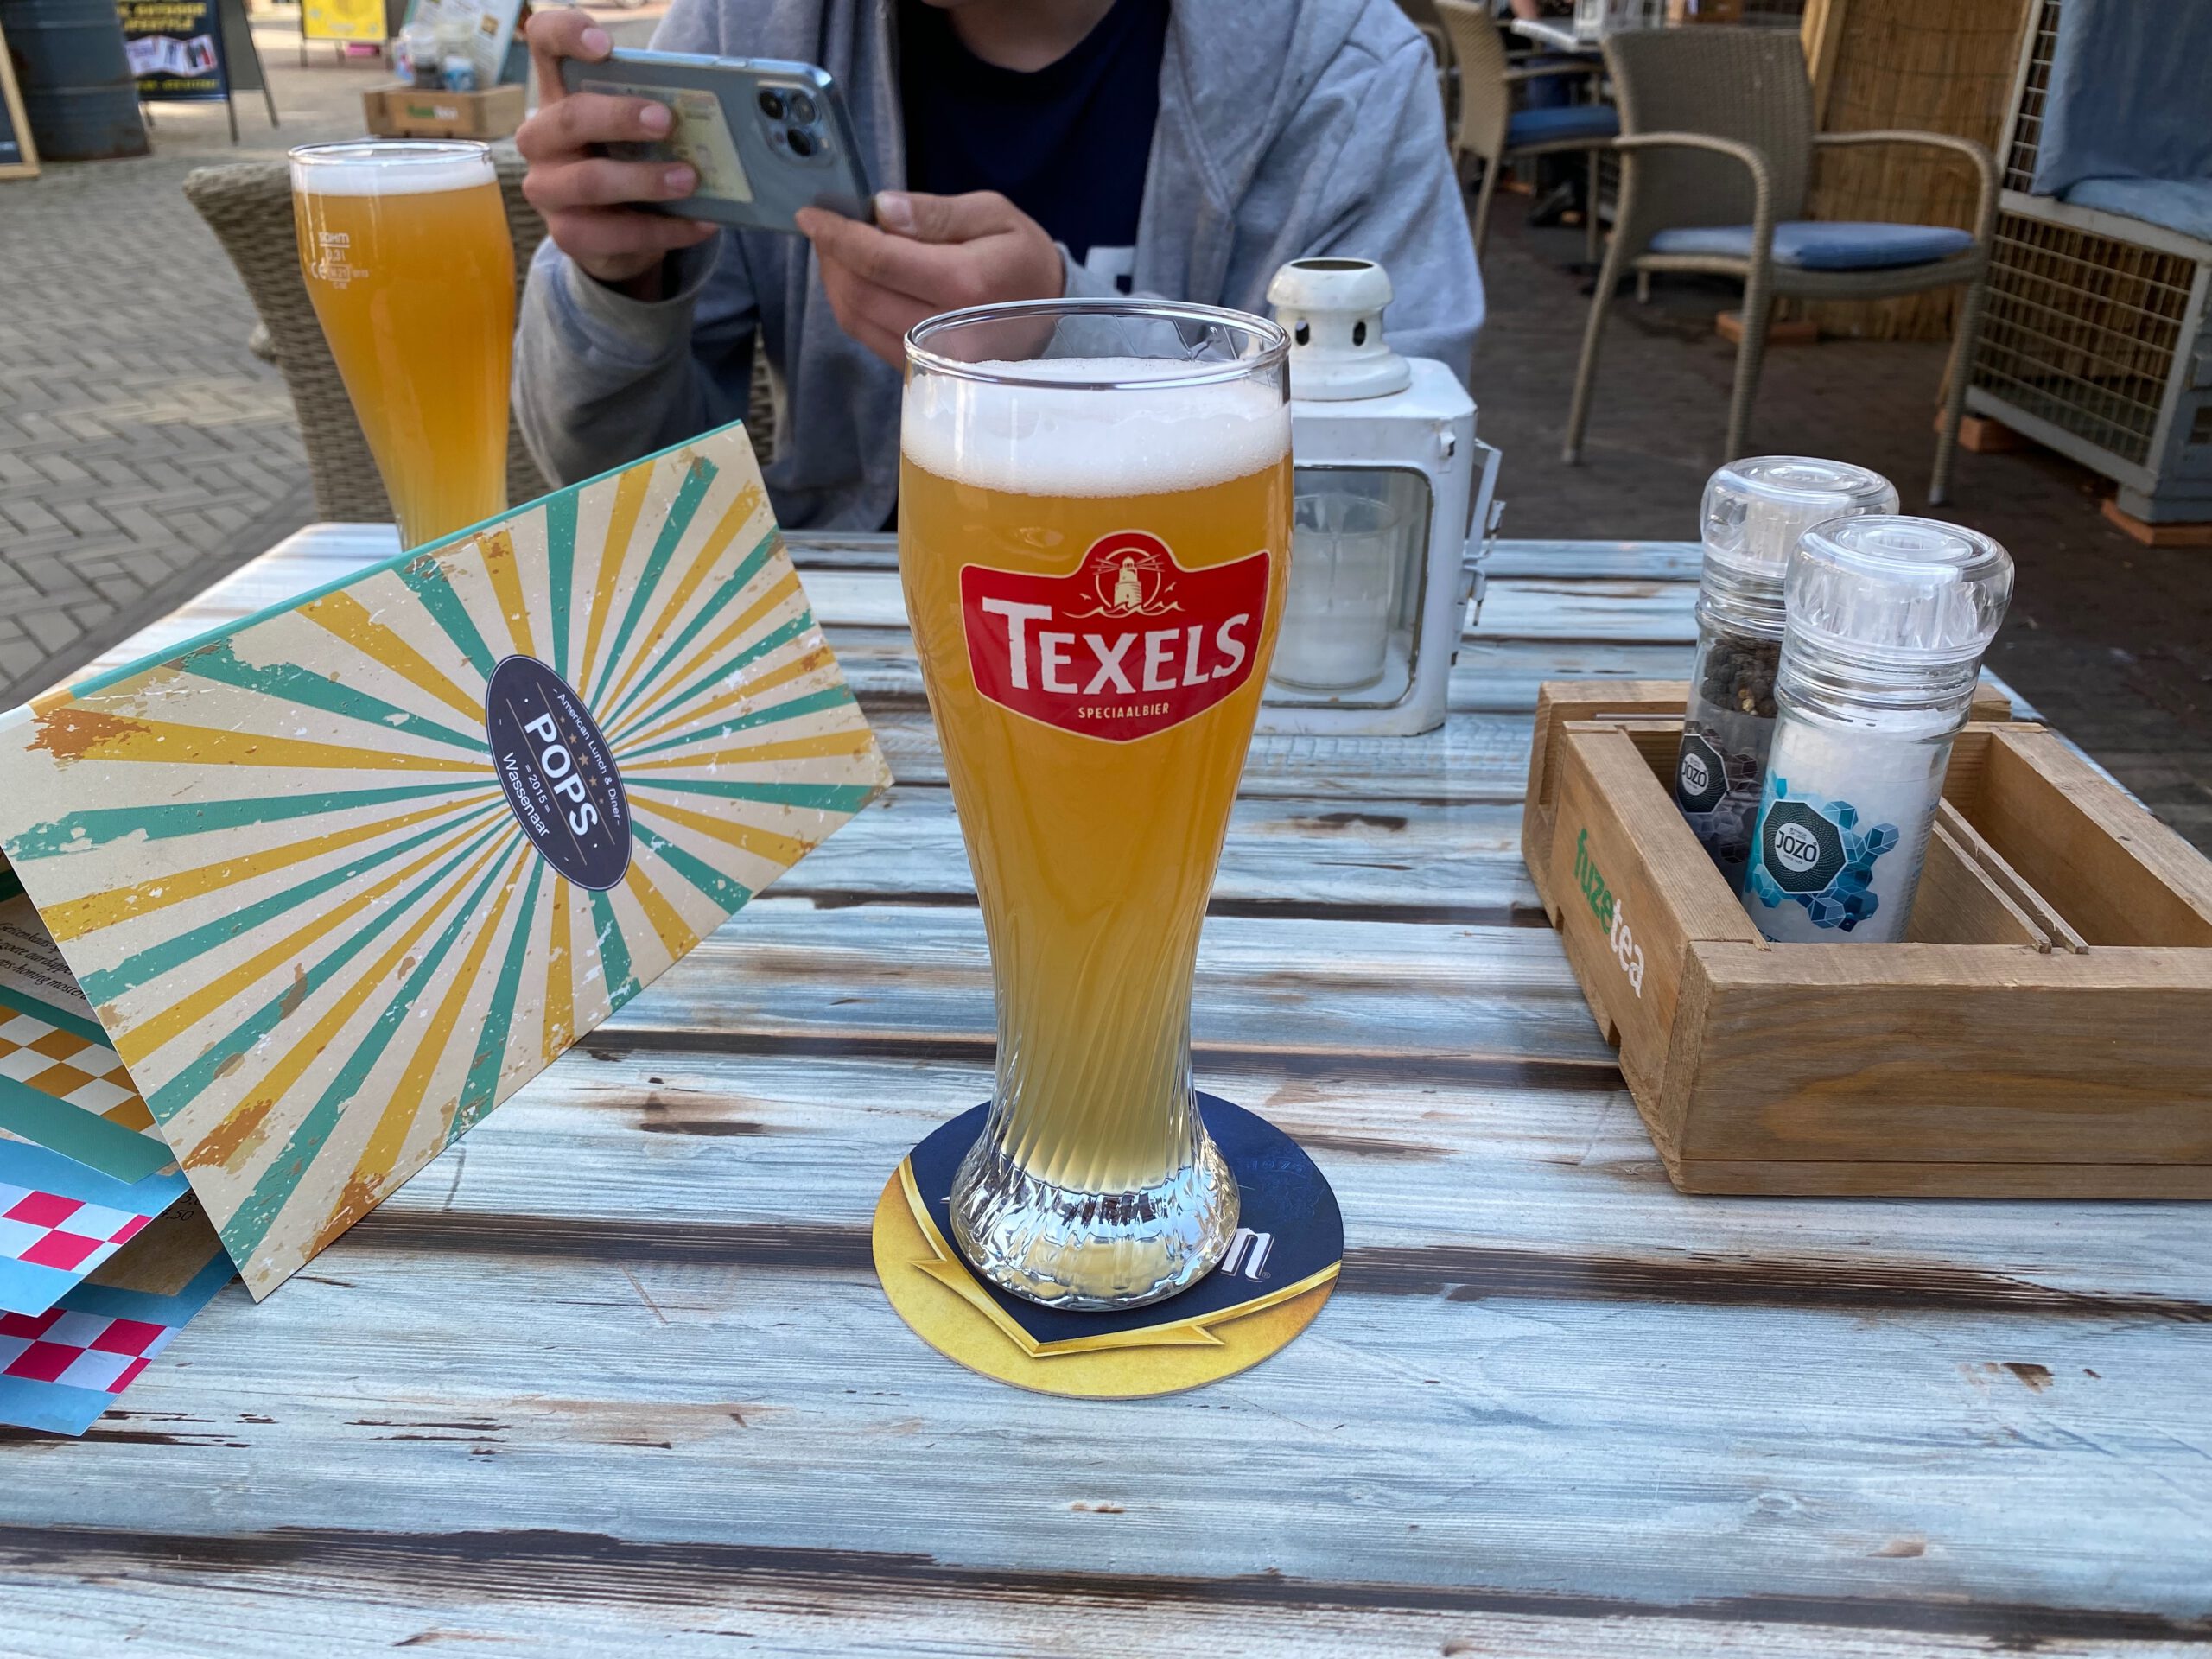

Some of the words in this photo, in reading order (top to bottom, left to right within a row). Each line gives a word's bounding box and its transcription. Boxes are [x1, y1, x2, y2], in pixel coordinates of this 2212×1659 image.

[981, 596, 1249, 695] TEXELS
[556, 692, 590, 740] American
[1077, 702, 1170, 719] SPECIAALBIER
[524, 712, 598, 836] POPS
[588, 740, 608, 776] Lunch
[1681, 760, 1707, 787] JOZO
[502, 752, 550, 837] Wassenaar
[528, 773, 548, 804] 2015
[604, 776, 613, 786] &
[607, 787, 621, 820] Diner
[1776, 830, 1817, 862] JOZO
